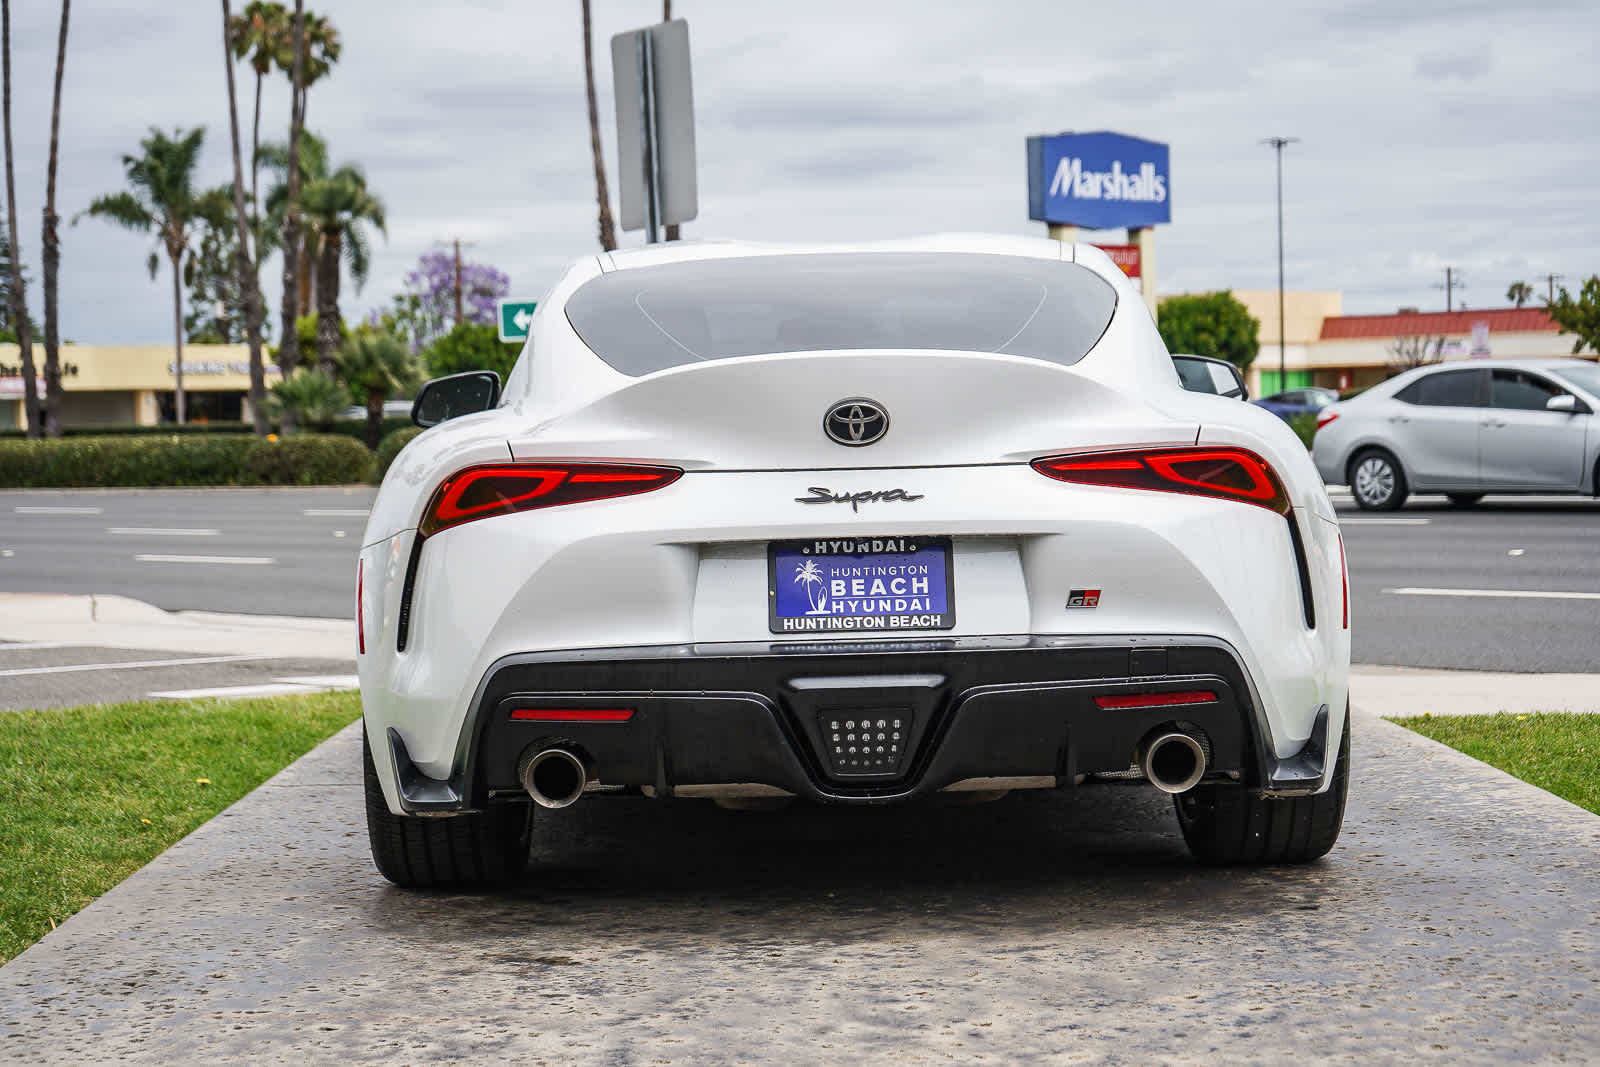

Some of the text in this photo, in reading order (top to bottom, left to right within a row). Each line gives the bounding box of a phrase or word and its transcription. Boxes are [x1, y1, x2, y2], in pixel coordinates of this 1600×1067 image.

[1049, 156, 1167, 203] Marshalls
[794, 487, 925, 513] Supra
[815, 540, 905, 554] HYUNDAI
[831, 565, 928, 577] HUNTINGTON
[831, 577, 929, 597] BEACH
[831, 598, 931, 614] HYUNDAI
[783, 615, 941, 630] HUNTINGTON BEACH
